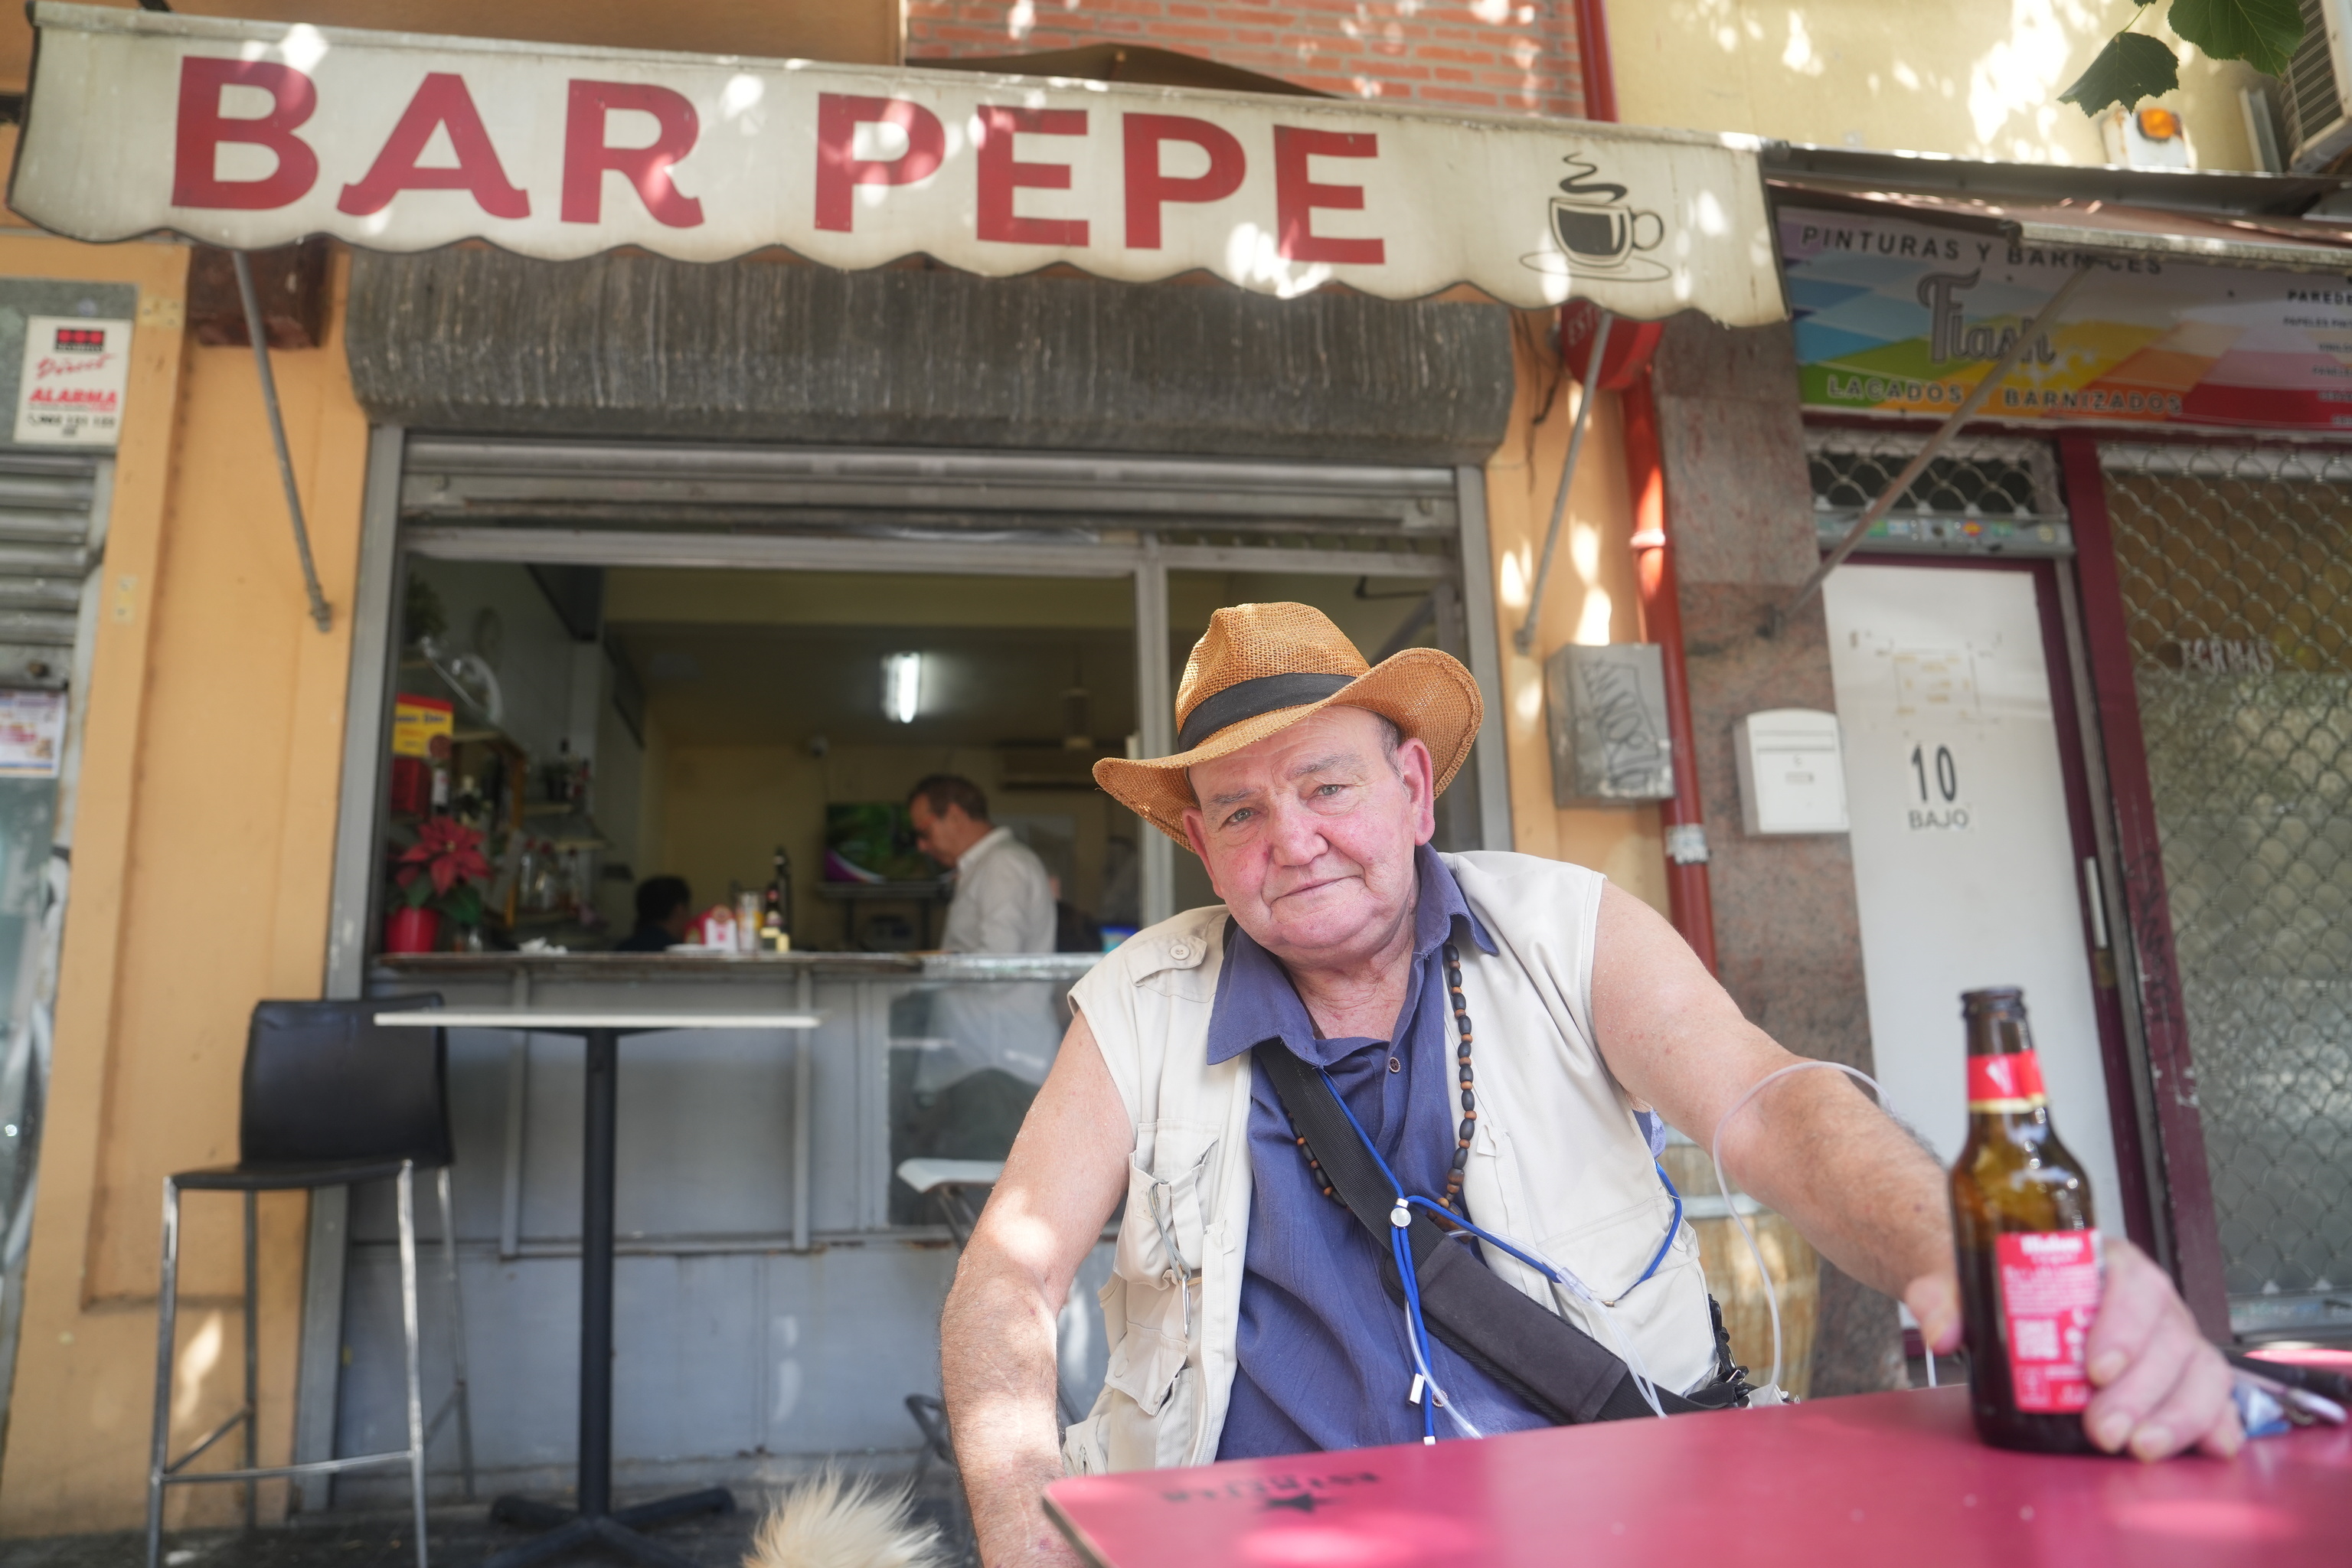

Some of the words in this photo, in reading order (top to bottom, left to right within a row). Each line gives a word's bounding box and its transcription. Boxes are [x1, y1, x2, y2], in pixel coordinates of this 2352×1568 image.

[172, 56, 704, 228] BAR
[813, 91, 1385, 266] PEPE
[1802, 226, 1960, 260] PINTURAS
[1975, 241, 1992, 263] Y
[2006, 245, 2162, 276] BARNCES
[28, 388, 118, 405] ALARMA
[1827, 374, 1964, 404] LACADOS
[2003, 387, 2183, 414] BARNIZADOS
[1912, 743, 1957, 803] 10
[1908, 808, 1971, 830] BAJO
